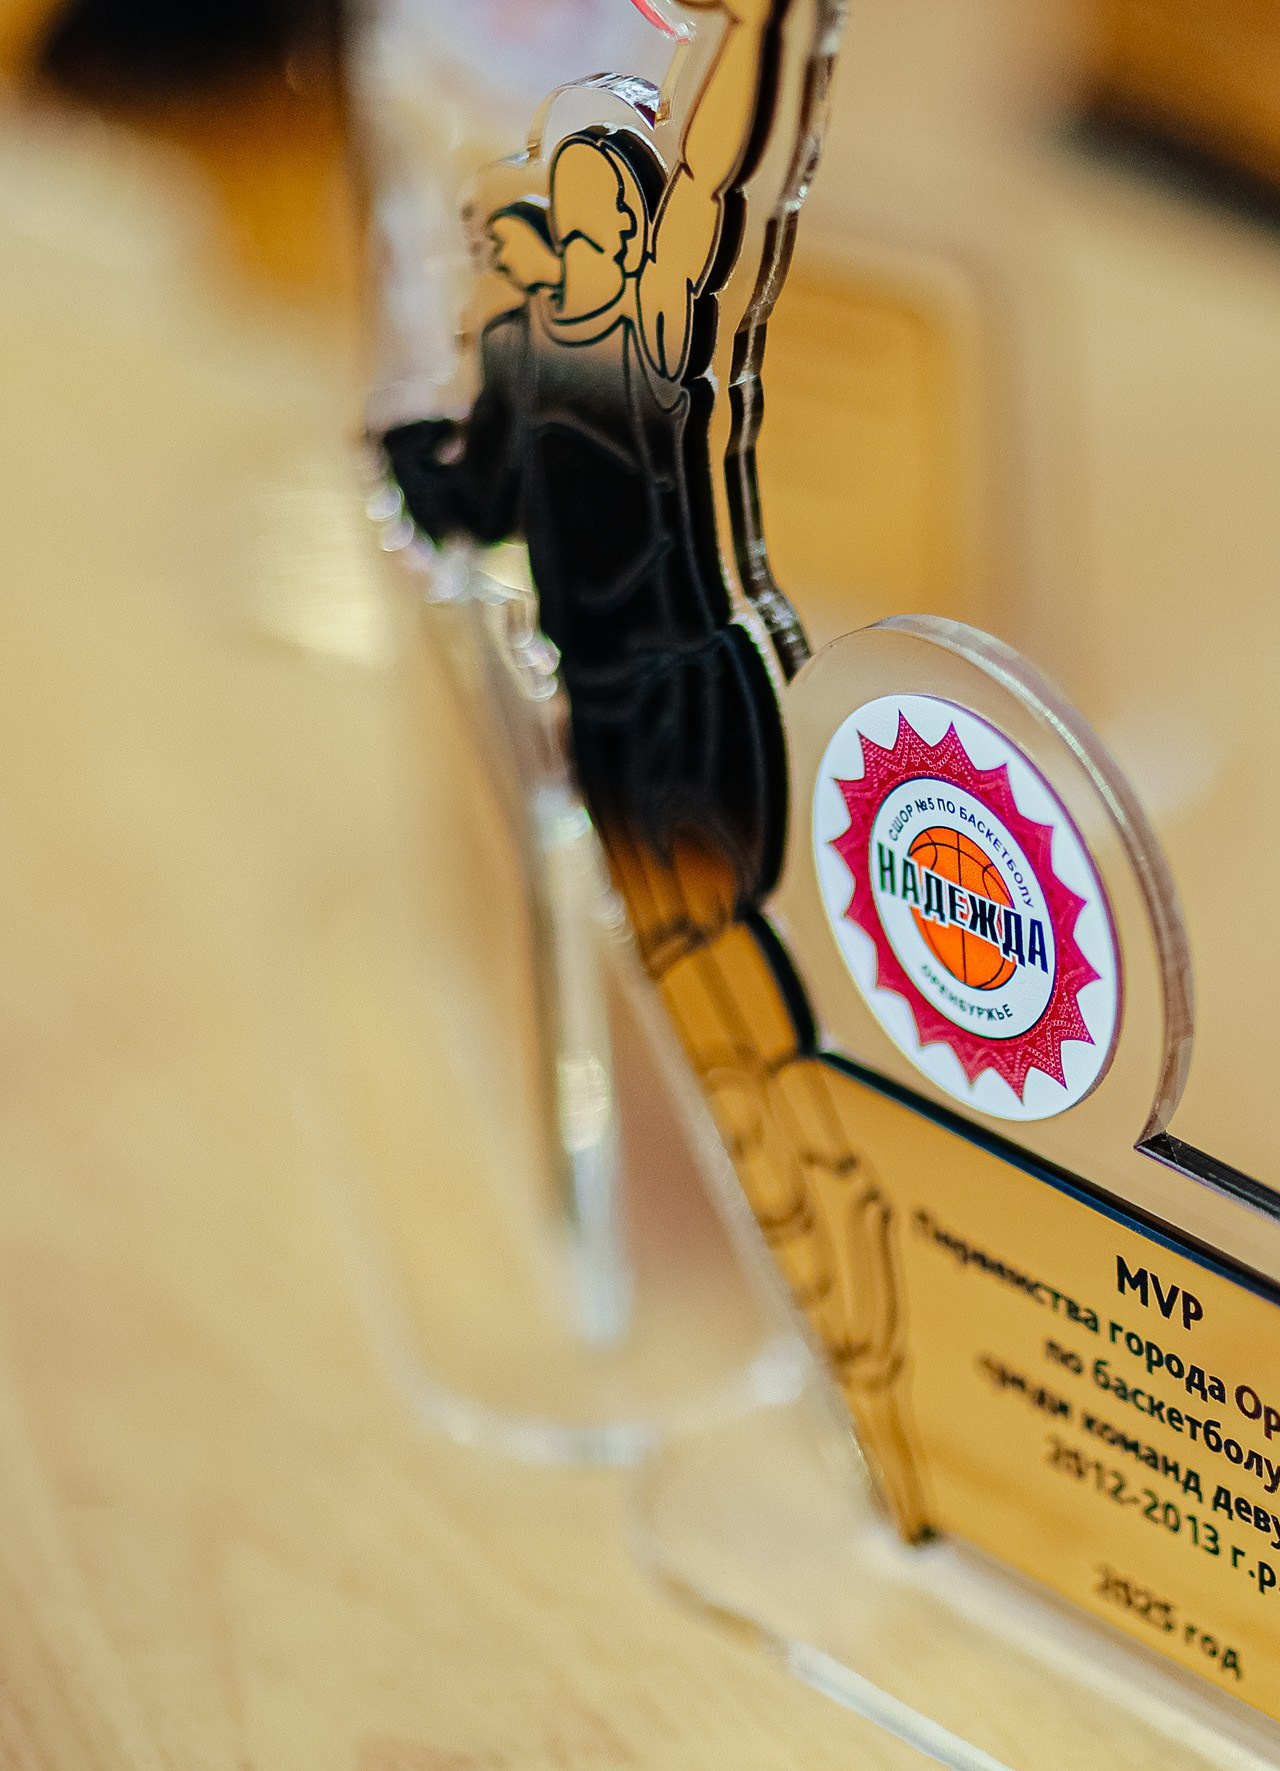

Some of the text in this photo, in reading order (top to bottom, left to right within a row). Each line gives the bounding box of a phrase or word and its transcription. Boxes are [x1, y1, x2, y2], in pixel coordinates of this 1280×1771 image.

[889, 798, 1035, 909] СШОР №5 ПО БАСКЕТБОЛУ
[876, 841, 1049, 973] НАДЕЖДА
[1115, 1254, 1204, 1330] MVP
[1044, 1338, 1084, 1376] по
[1109, 1317, 1226, 1405] города
[1081, 1411, 1204, 1504] команд
[1183, 1622, 1244, 1682] год
